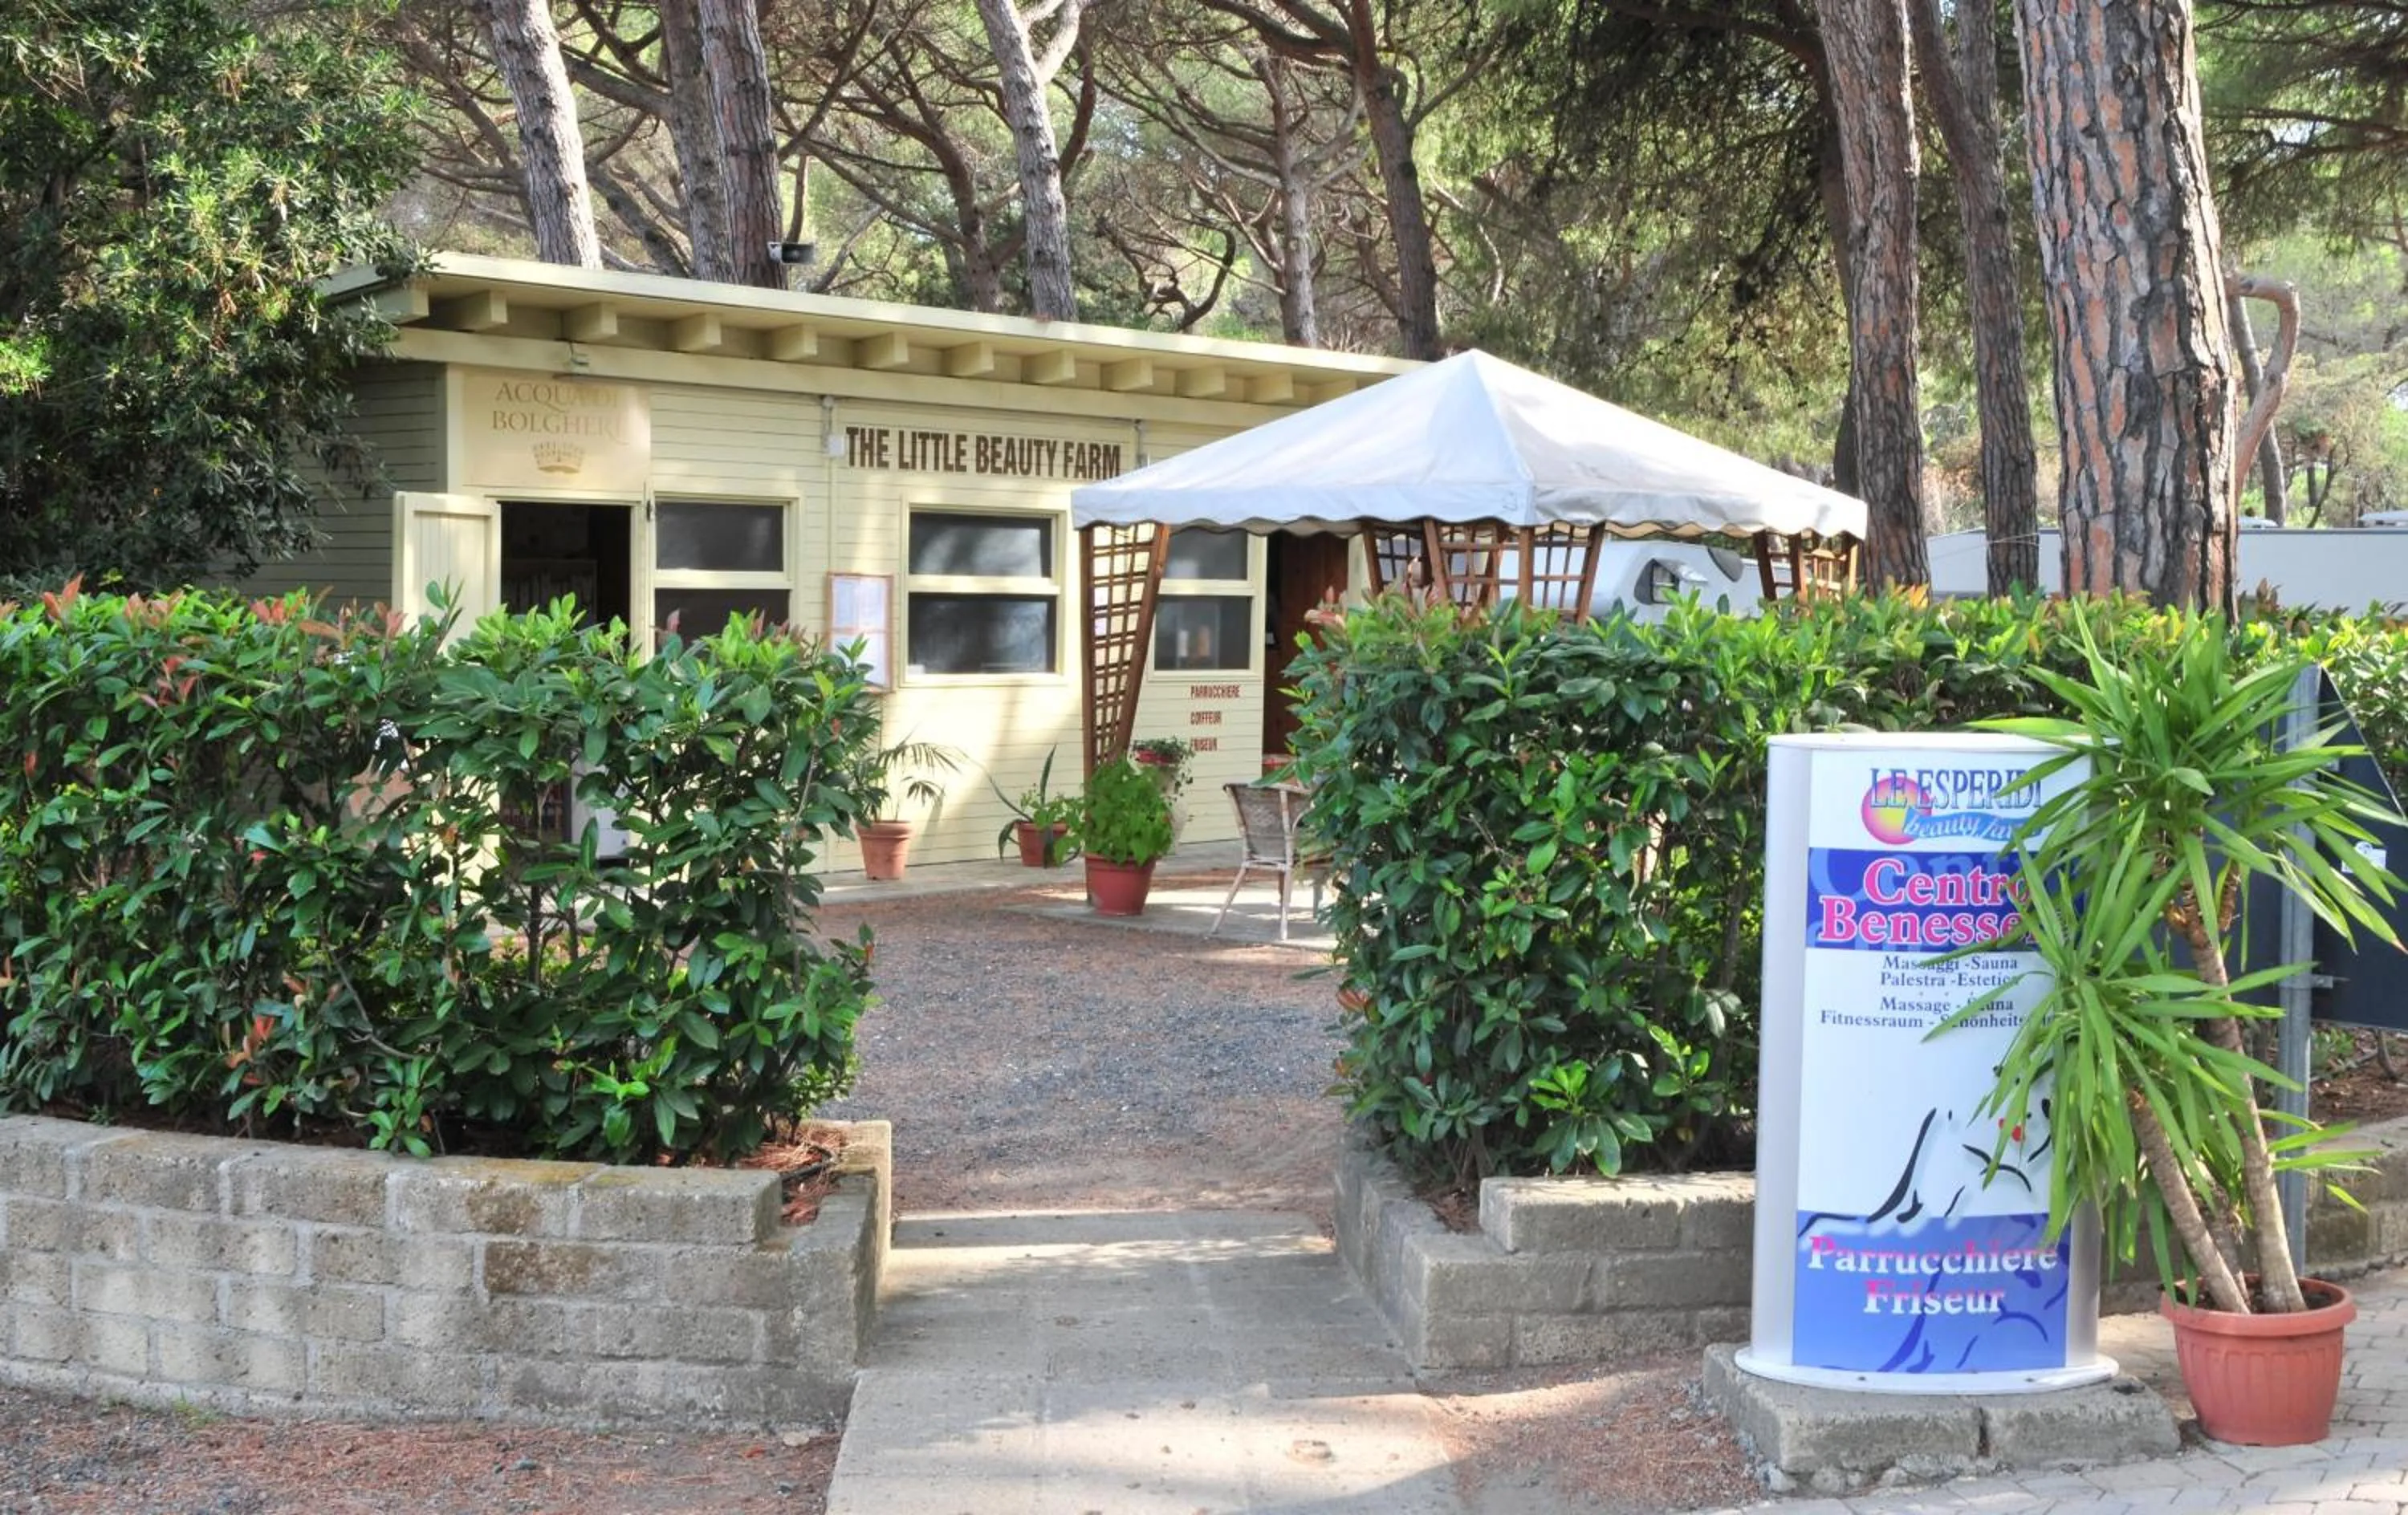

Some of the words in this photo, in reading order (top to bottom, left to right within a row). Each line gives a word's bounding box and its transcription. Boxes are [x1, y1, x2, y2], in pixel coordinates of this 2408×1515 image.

[491, 410, 628, 445] BOLGHERI
[846, 426, 889, 469] THE
[898, 429, 967, 473] LITTLE
[975, 434, 1057, 477] BEAUTY
[1064, 441, 1121, 481] FARM
[1190, 684, 1240, 699] PARRUCCHIERE
[1870, 768, 1908, 808] LE
[1916, 769, 2042, 810] ESPERIDI
[1819, 895, 2040, 945] Benesse
[1880, 972, 1945, 987] Palestra
[1820, 1009, 1923, 1028] Fitnessraum
[1880, 997, 1951, 1014] Massage
[1807, 1235, 2058, 1274] Parrucchiere
[1864, 1278, 2004, 1315] Friseur
